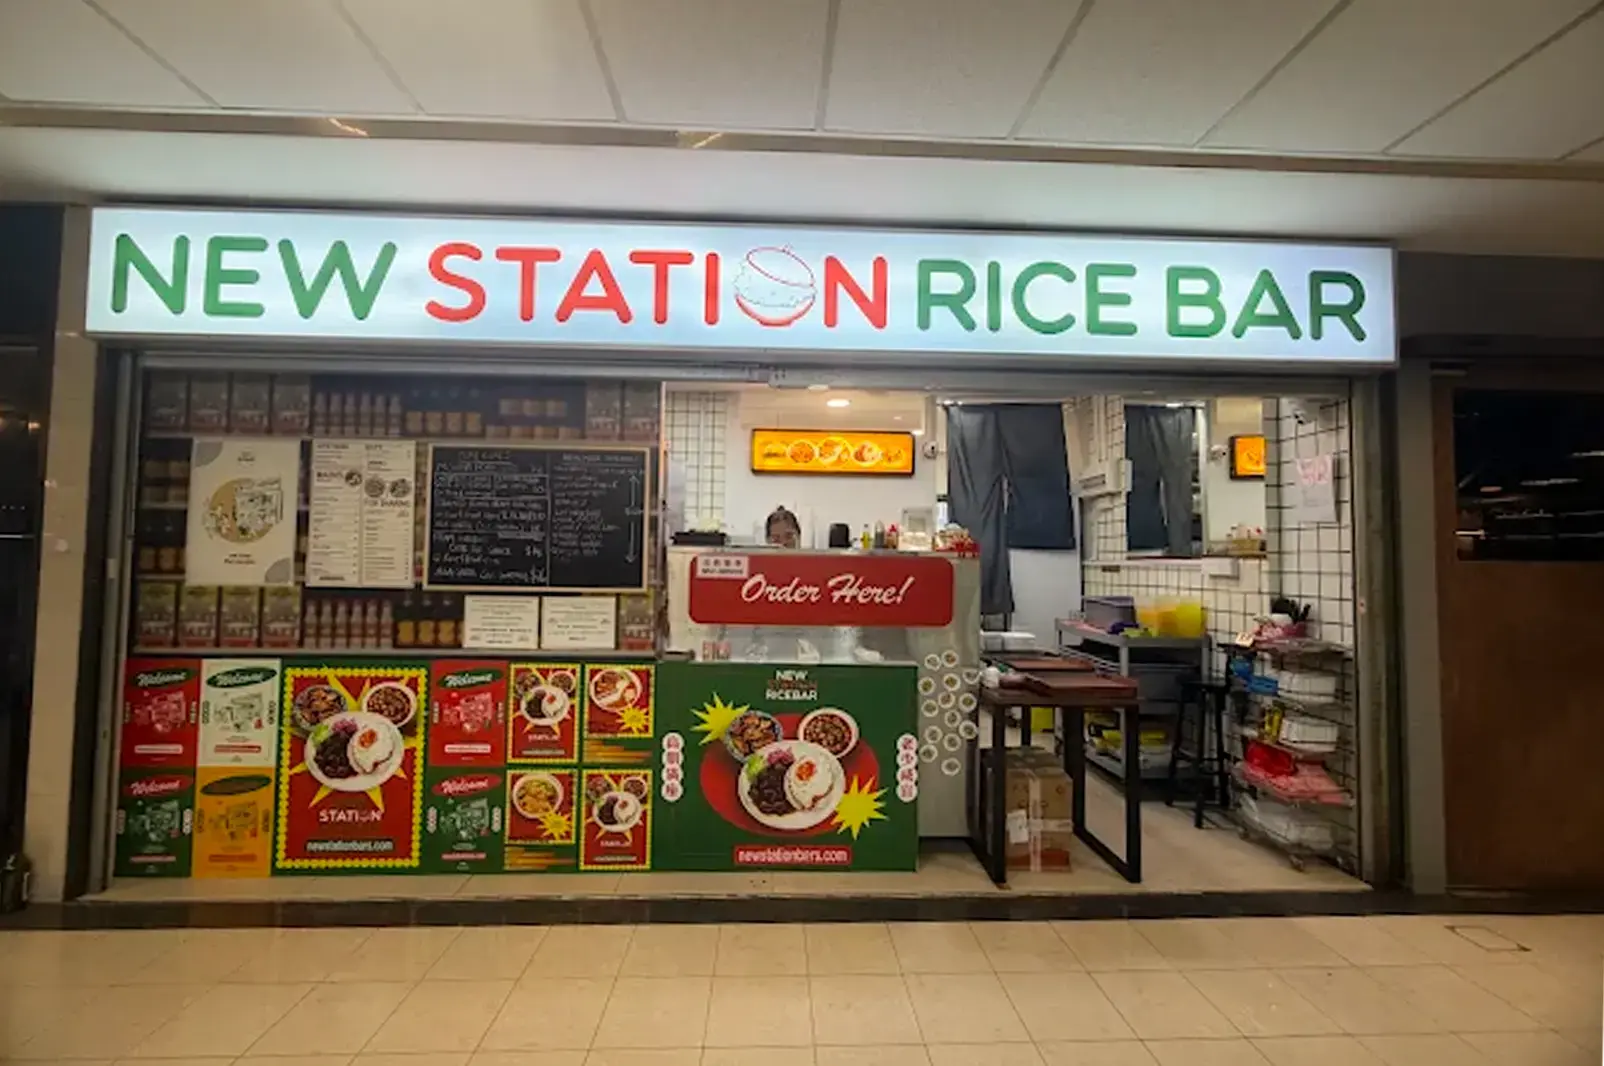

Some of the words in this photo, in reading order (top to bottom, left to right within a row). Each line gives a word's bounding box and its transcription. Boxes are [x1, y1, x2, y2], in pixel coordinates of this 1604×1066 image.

[111, 234, 397, 320] NEW
[918, 260, 1137, 336] RICE
[1167, 267, 1365, 341] BAR
[741, 574, 821, 603] Order
[827, 574, 915, 605] Here!
[775, 670, 809, 681] NEW
